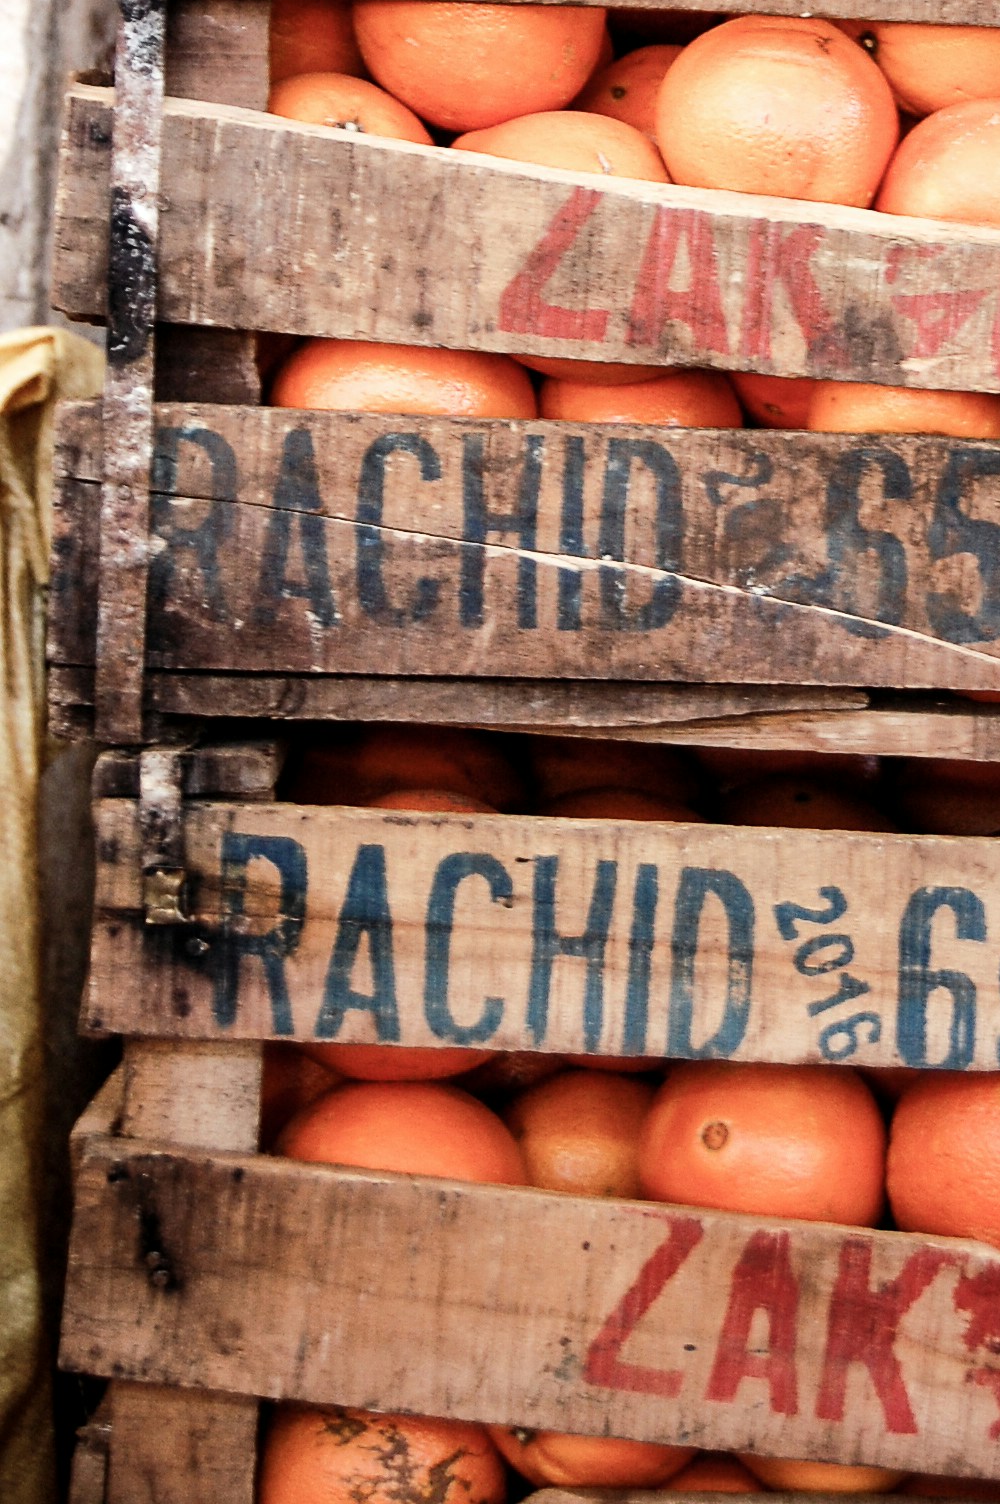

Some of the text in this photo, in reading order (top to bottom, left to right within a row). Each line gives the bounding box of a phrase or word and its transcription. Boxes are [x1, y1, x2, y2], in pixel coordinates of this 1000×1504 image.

[498, 186, 850, 368] ZAK
[150, 426, 684, 633] RACHID
[213, 831, 755, 1060] RACHID
[775, 884, 883, 1062] 2016
[585, 1212, 966, 1435] ZAK
